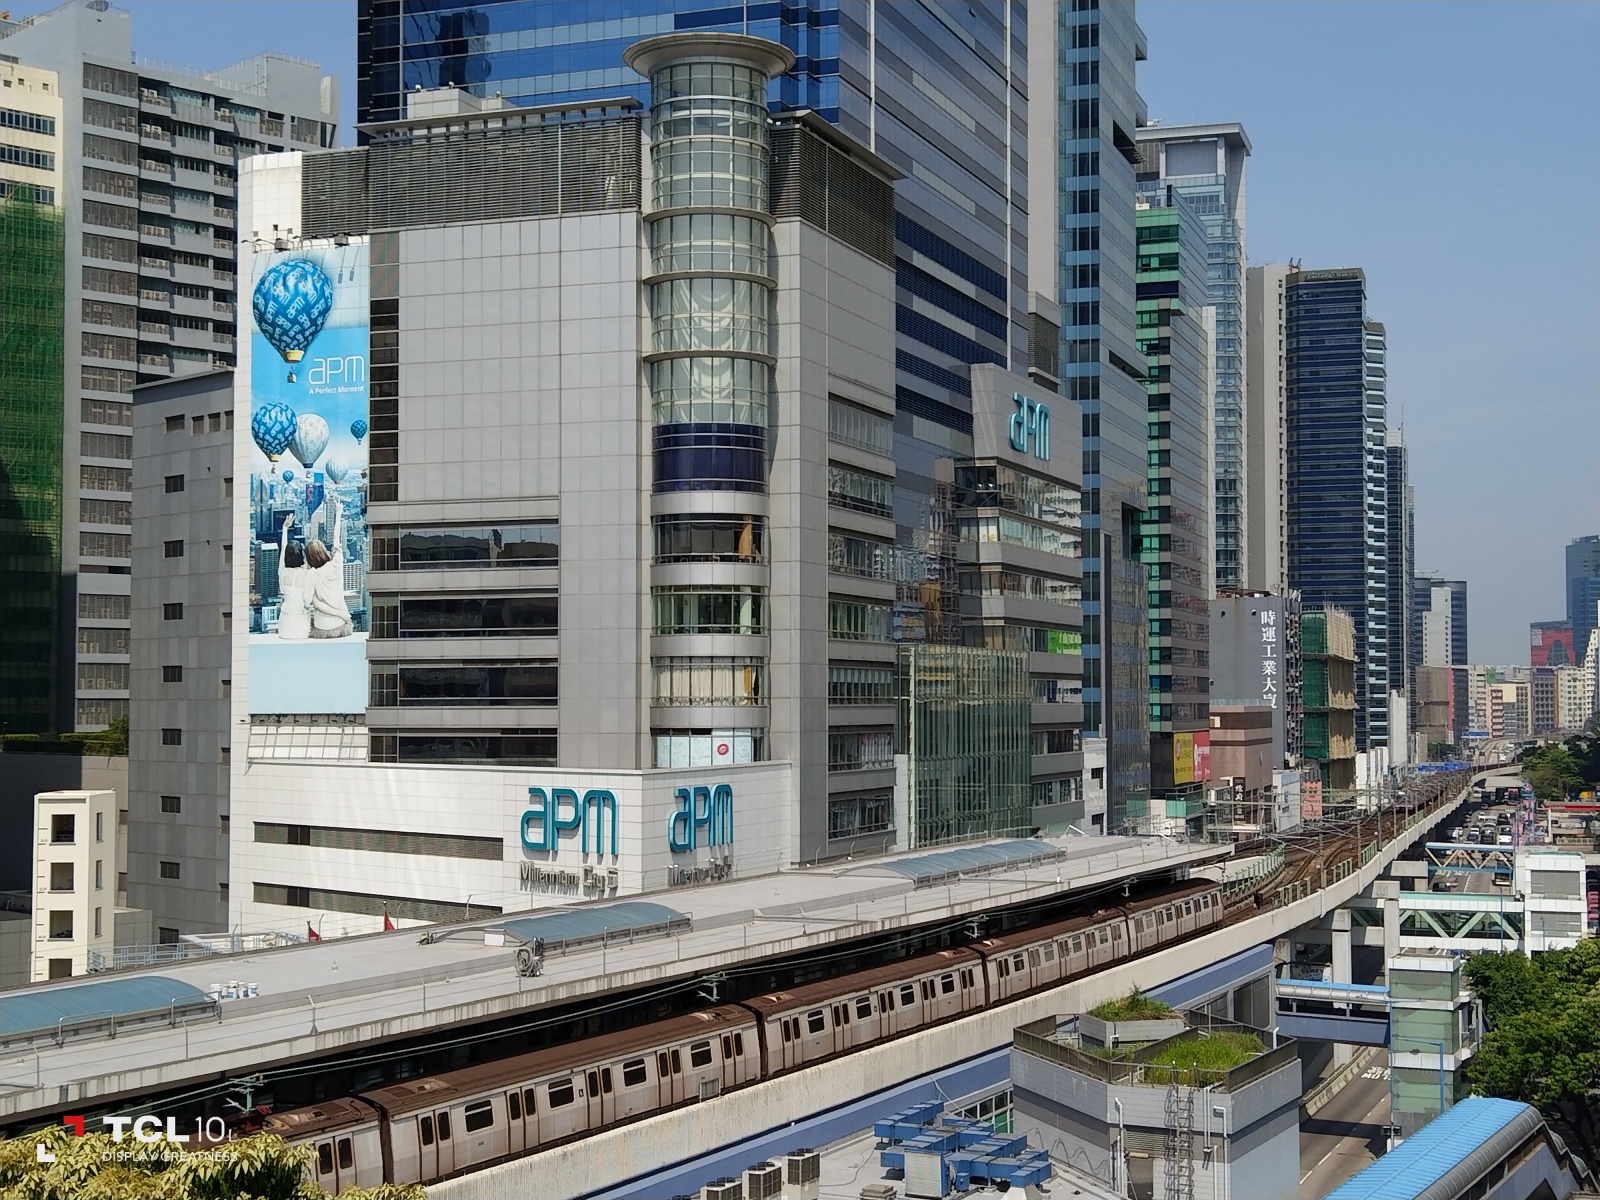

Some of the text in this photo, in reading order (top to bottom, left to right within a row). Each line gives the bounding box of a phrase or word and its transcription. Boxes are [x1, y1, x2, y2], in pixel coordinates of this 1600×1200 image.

[308, 355, 365, 385] apm
[314, 387, 337, 395] Perfect
[337, 385, 365, 393] Moment
[1009, 391, 1051, 462] apm
[520, 786, 619, 856] apm
[668, 783, 733, 853] apm
[519, 860, 619, 891] Millennium City 5
